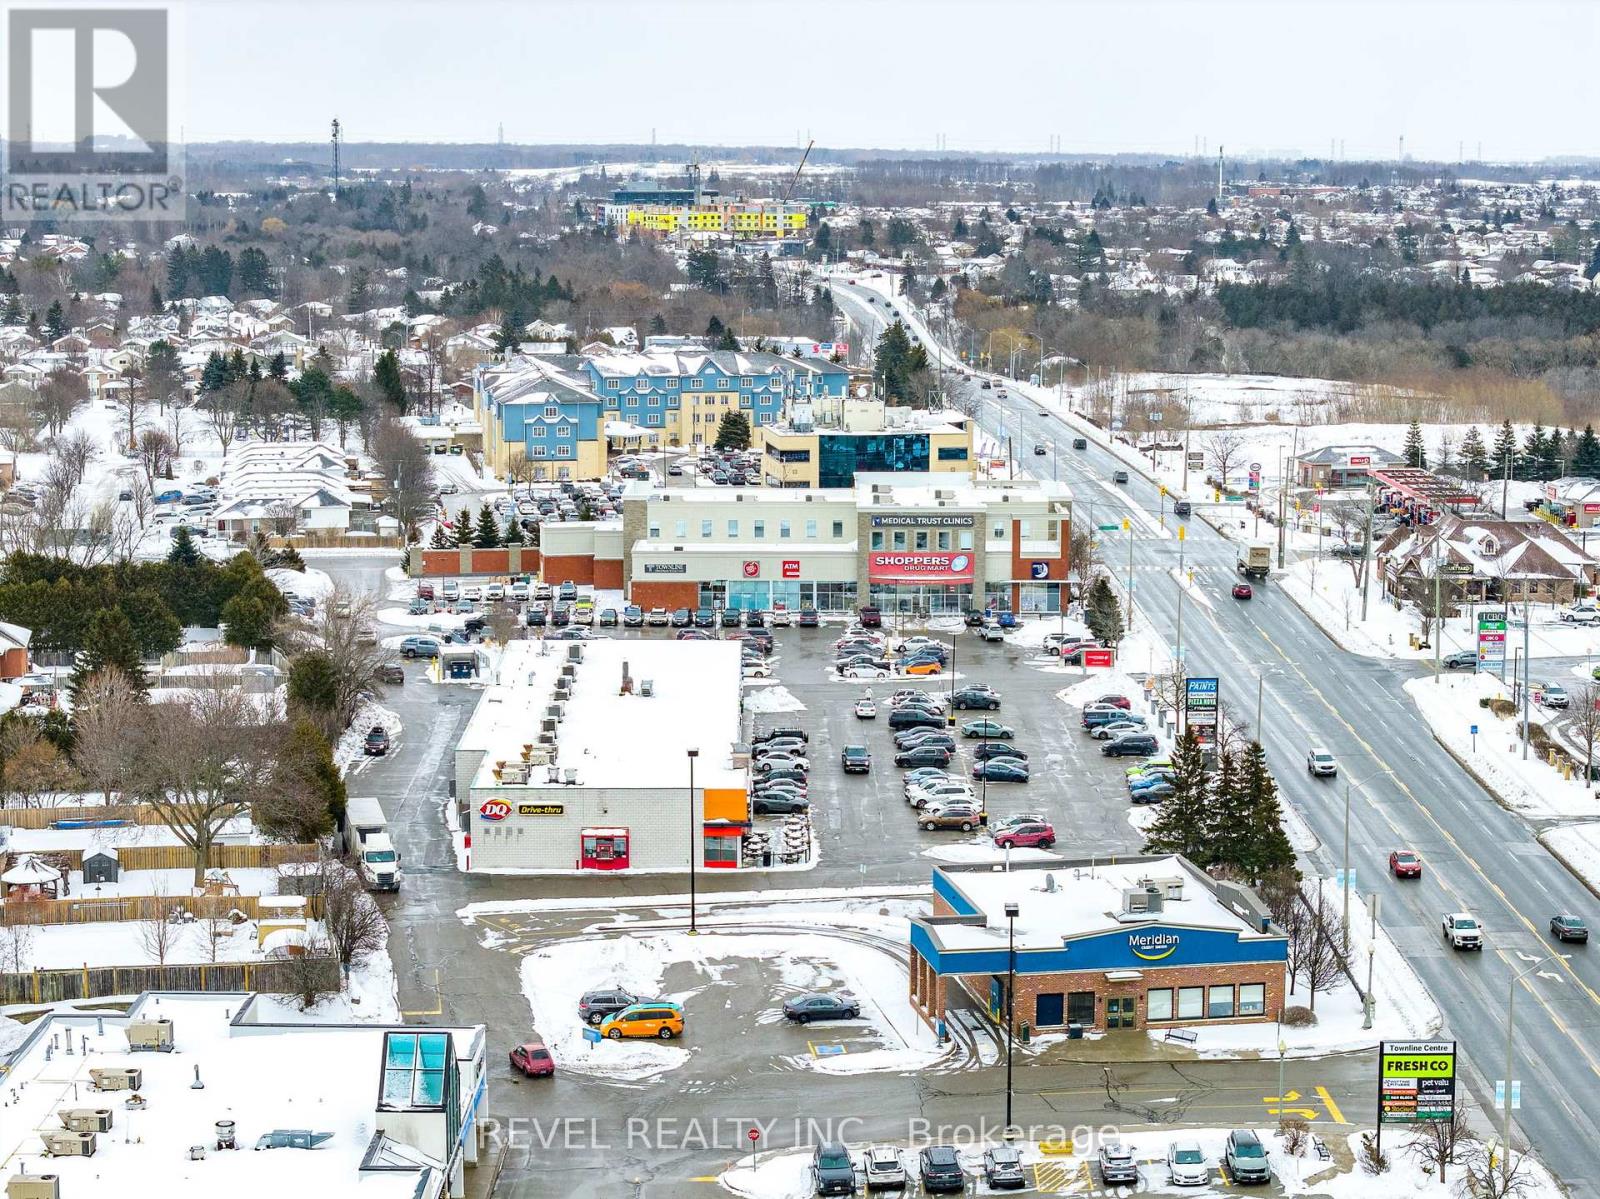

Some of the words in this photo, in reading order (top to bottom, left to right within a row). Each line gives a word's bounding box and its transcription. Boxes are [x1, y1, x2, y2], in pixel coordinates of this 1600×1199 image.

[881, 517, 915, 525] MEDICAL
[918, 517, 941, 525] TRUST
[943, 517, 973, 525] CLINICS
[876, 556, 949, 565] SHOPPERS
[1188, 681, 1216, 690] PAINTS
[485, 804, 507, 816] DQ
[1129, 934, 1180, 945] Meridian
